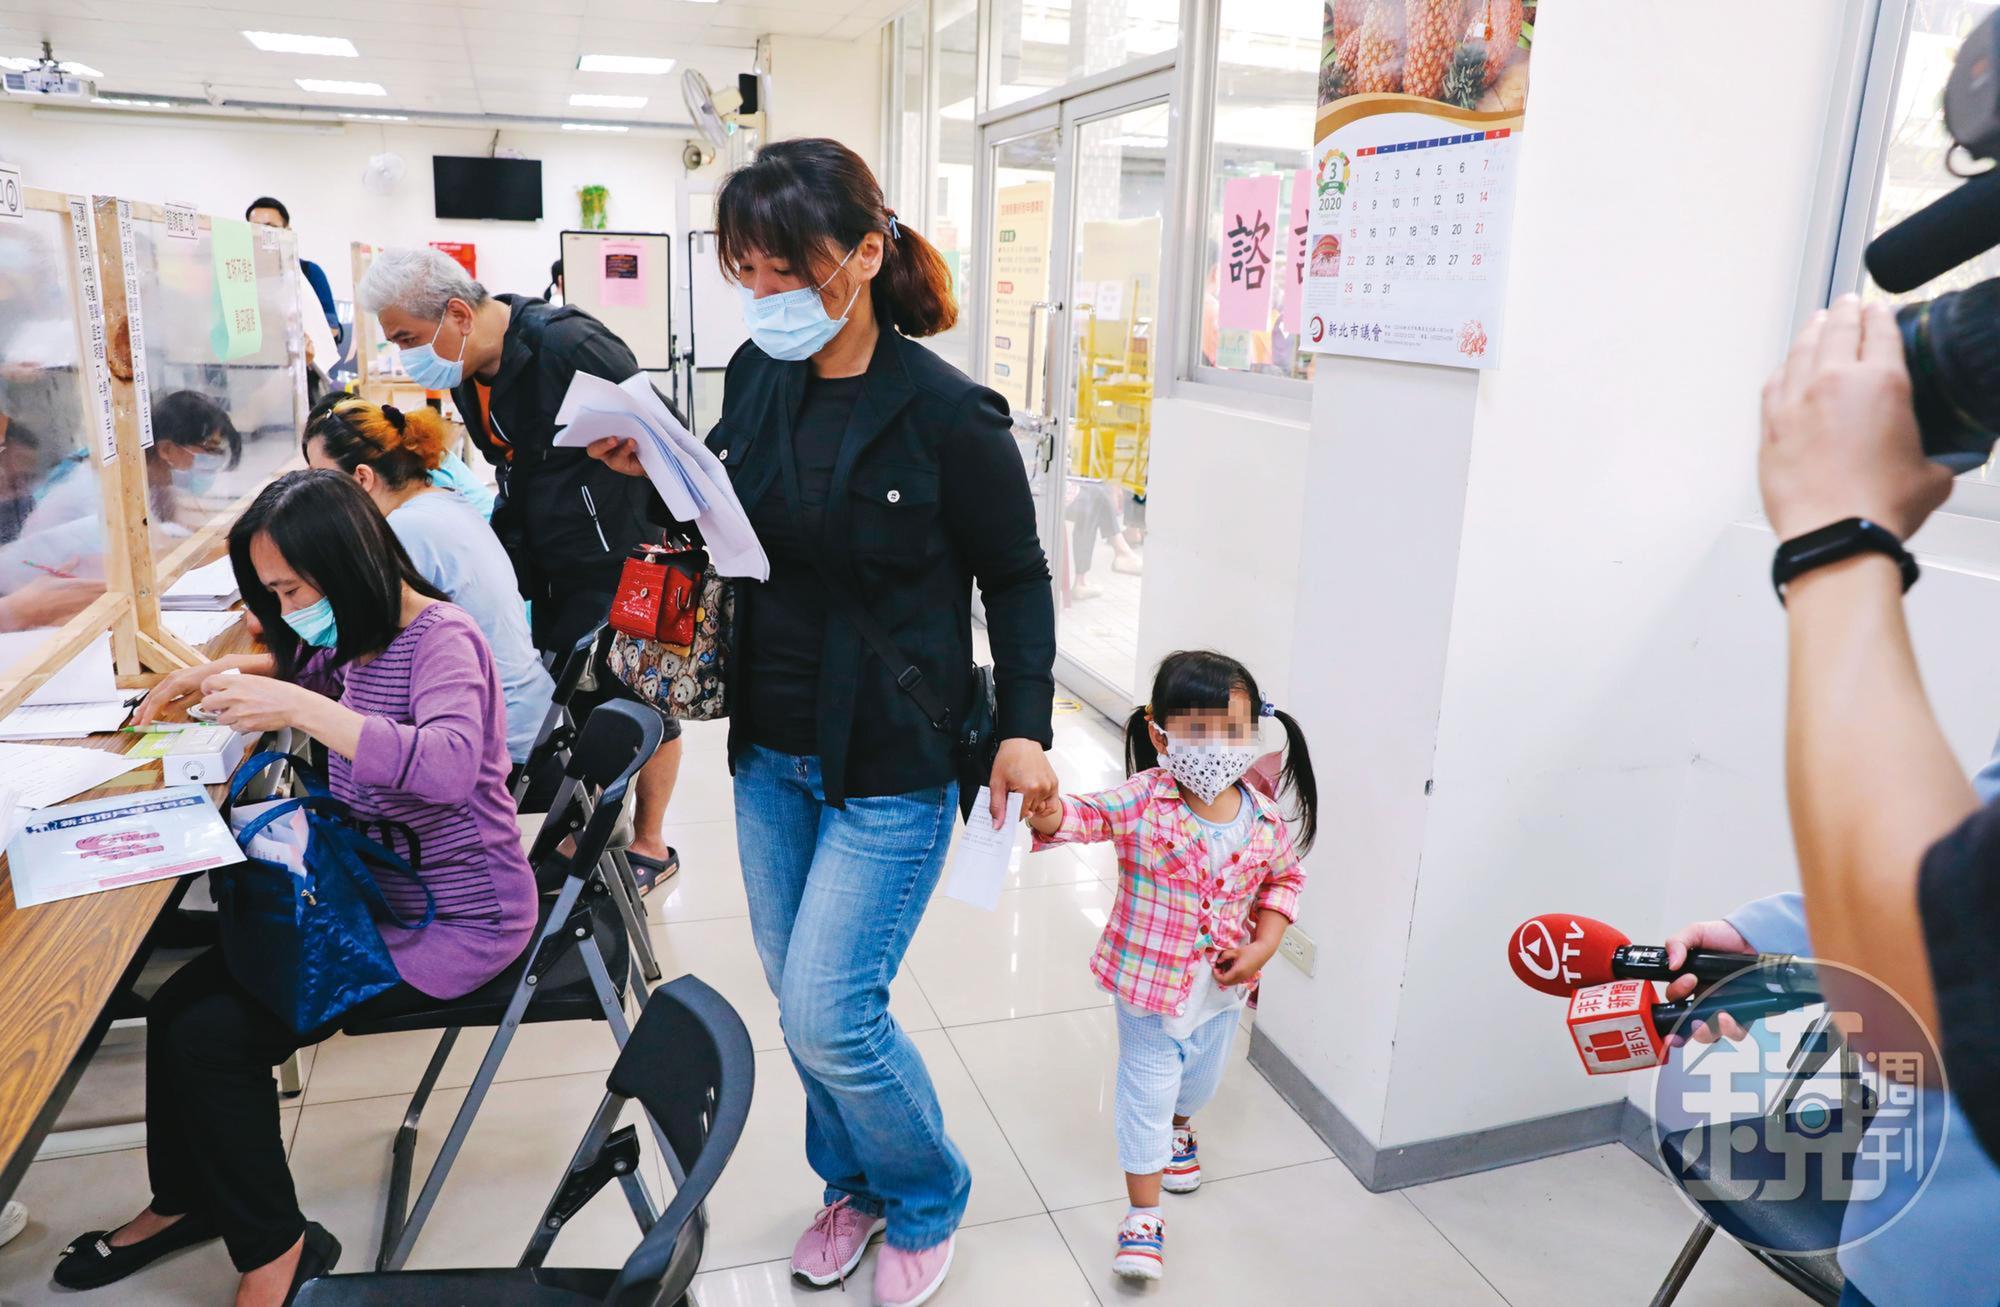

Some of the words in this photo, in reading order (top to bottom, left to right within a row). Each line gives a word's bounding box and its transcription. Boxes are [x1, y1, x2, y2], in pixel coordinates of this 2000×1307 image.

[1330, 162, 1337, 180] 3
[1374, 171, 1380, 182] 2
[1394, 169, 1400, 180] 3
[1415, 167, 1421, 177] 4
[1436, 165, 1443, 175] 5
[1459, 162, 1465, 174] 6
[1483, 160, 1488, 170] 7
[1319, 197, 1342, 211] 2020
[1352, 201, 1358, 211] 8
[1371, 200, 1377, 210] 9
[1392, 198, 1399, 209] 10
[1413, 197, 1419, 207] 11
[1434, 194, 1441, 205] 12
[1456, 192, 1464, 204] 13
[1480, 191, 1488, 202] 14
[1350, 227, 1357, 238] 15
[1369, 227, 1376, 238] 16
[1389, 227, 1396, 237] 17
[1410, 225, 1417, 237] 18
[1431, 225, 1439, 236] 19
[1452, 223, 1462, 235] 20
[1475, 223, 1484, 234] 21
[1228, 209, 1271, 290] 諮
[1347, 256, 1355, 266] 22
[1366, 256, 1375, 266] 23
[1385, 256, 1394, 266] 24
[1406, 255, 1415, 266] 25
[1427, 254, 1436, 266] 26
[1448, 254, 1459, 266] 27
[1472, 254, 1482, 266] 28
[1344, 283, 1353, 293] 29
[1363, 283, 1372, 293] 30
[1382, 283, 1390, 294] 31
[1328, 321, 1383, 343] 新北市議會
[1561, 921, 1585, 984] TTV
[1576, 986, 1607, 1014] 非凡
[1607, 982, 1639, 1010] 新聞
[1625, 1026, 1650, 1057] 非凡
